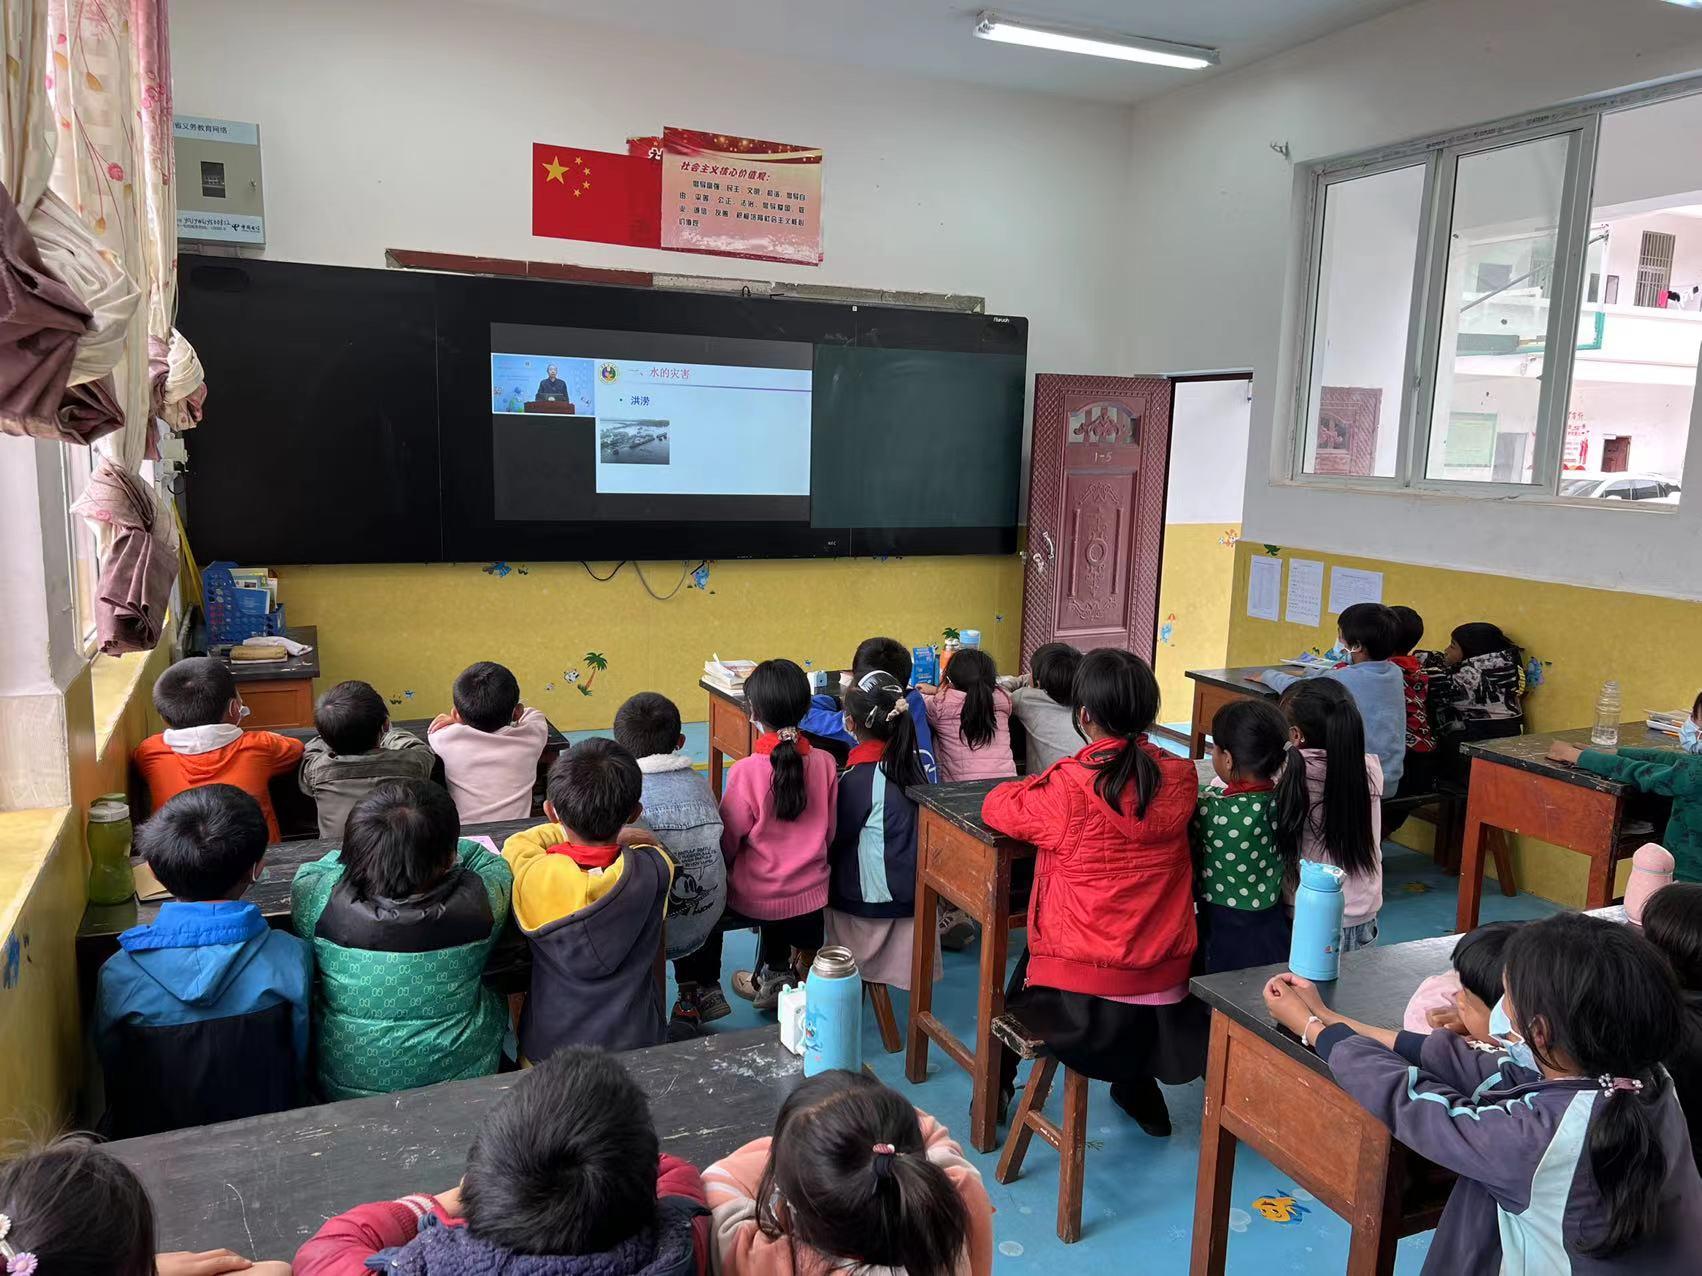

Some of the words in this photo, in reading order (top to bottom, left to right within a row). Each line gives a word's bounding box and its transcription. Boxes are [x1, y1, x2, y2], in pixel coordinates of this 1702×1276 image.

[627, 367, 690, 379] 一、水的灾害
